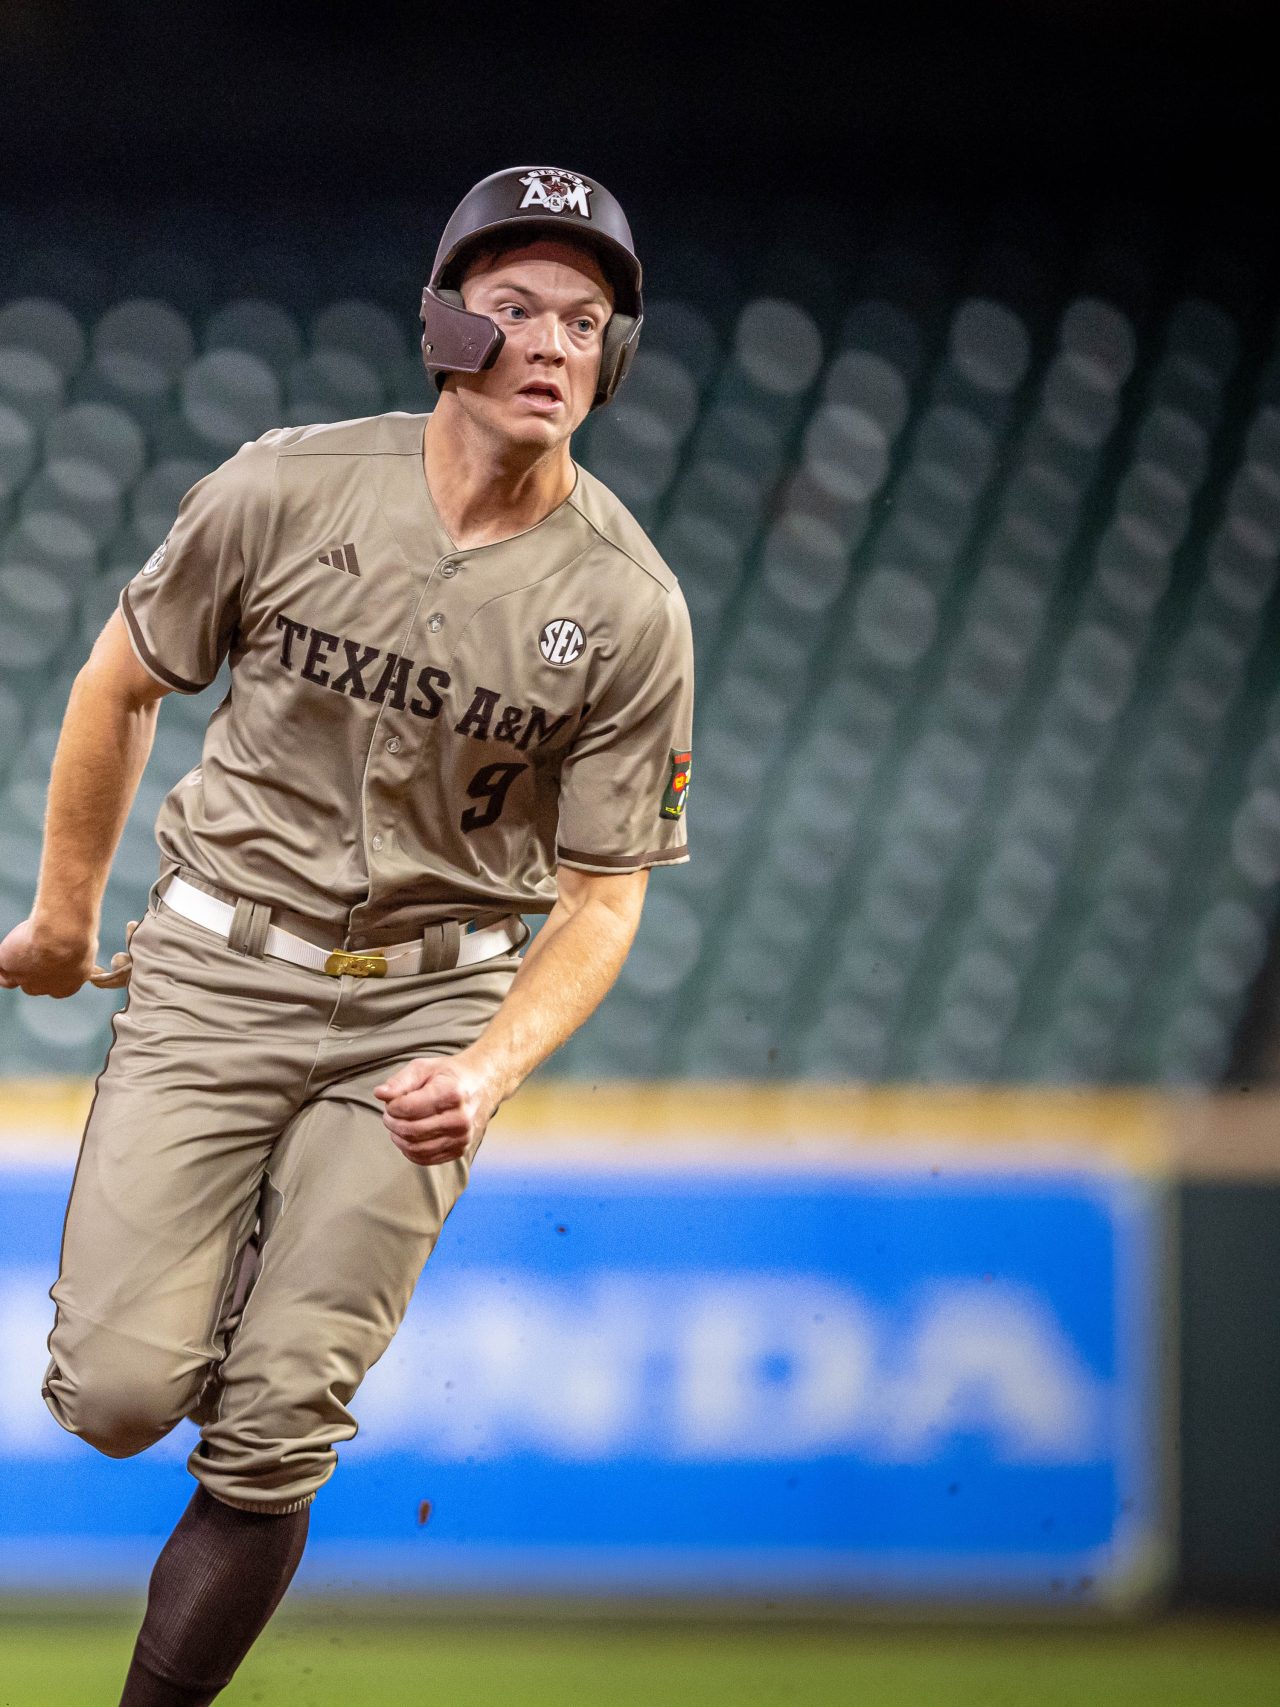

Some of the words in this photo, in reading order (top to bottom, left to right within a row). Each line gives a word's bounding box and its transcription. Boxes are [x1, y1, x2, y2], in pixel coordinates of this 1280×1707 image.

[534, 169, 577, 182] TEXAS
[539, 619, 585, 664] SEC
[276, 613, 452, 720] TEXAS
[454, 685, 592, 751] A&M
[459, 762, 530, 834] 9
